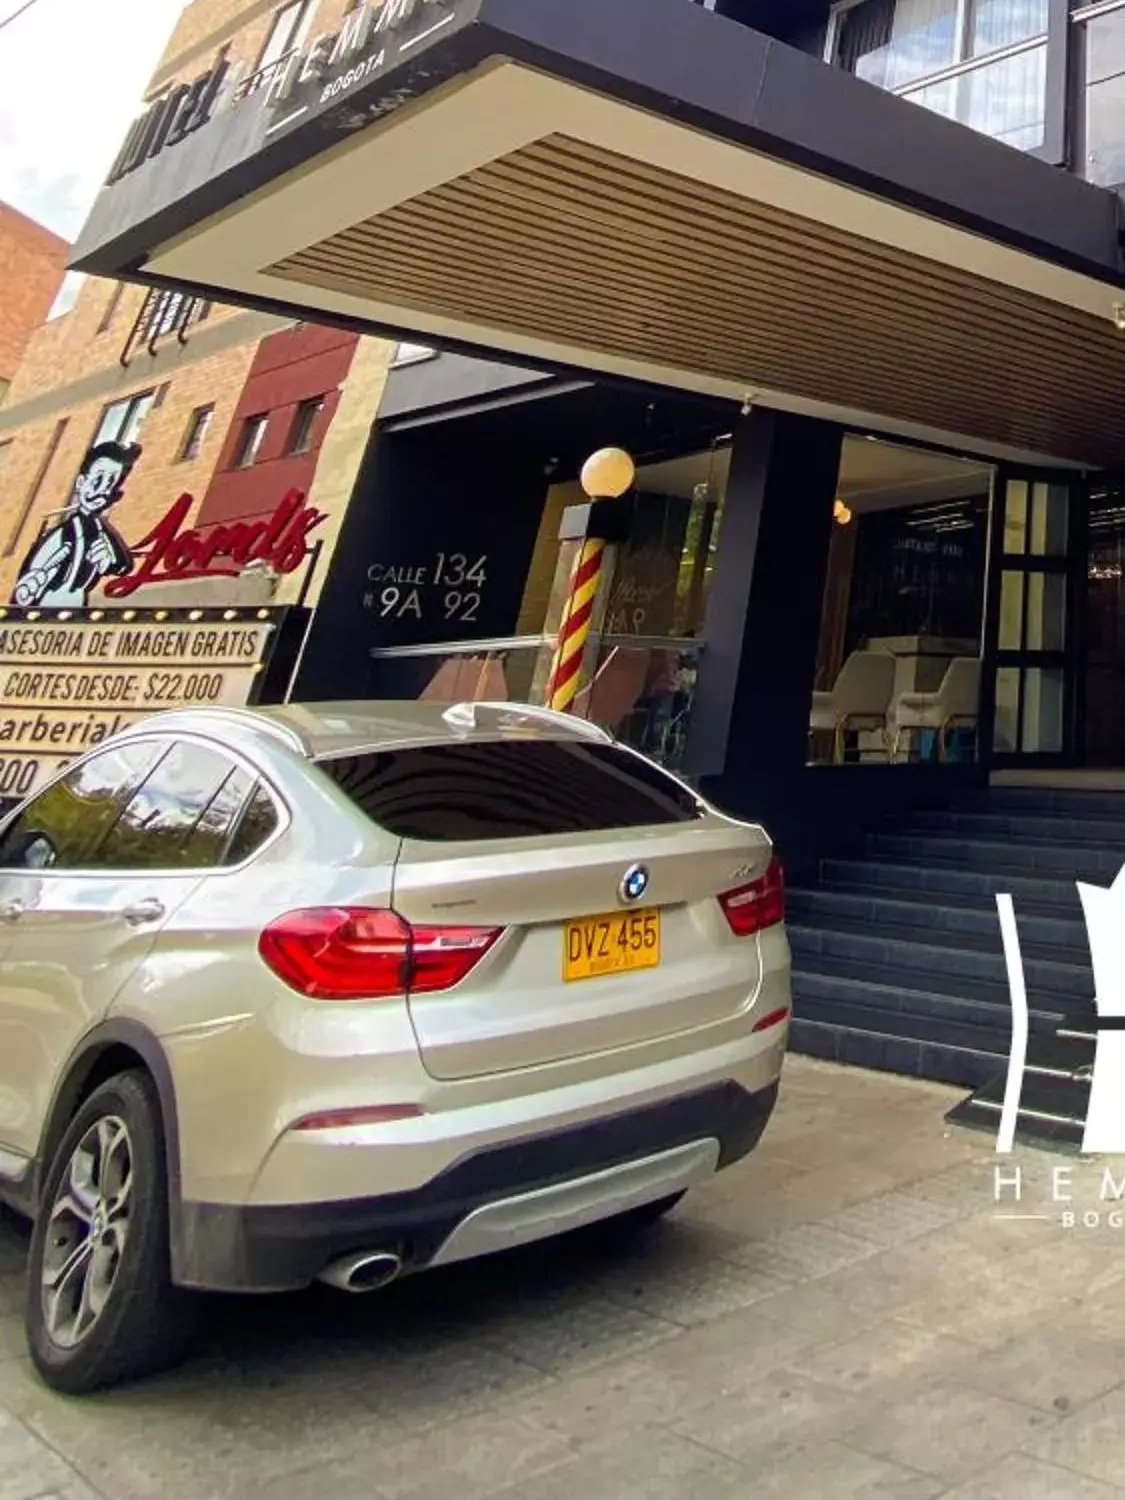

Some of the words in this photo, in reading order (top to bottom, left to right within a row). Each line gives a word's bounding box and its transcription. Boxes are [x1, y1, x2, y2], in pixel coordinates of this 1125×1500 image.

[367, 563, 427, 585] CALLE
[434, 552, 487, 588] 134
[380, 586, 422, 619] 9A
[444, 591, 481, 621] 92
[0, 629, 84, 656] ASESORIA
[87, 631, 114, 657] DE
[115, 631, 189, 657] IMAGEN
[191, 630, 258, 657] GRATIS
[143, 672, 223, 701] $22.000
[569, 921, 610, 964] DVZ
[618, 914, 658, 953] 455
